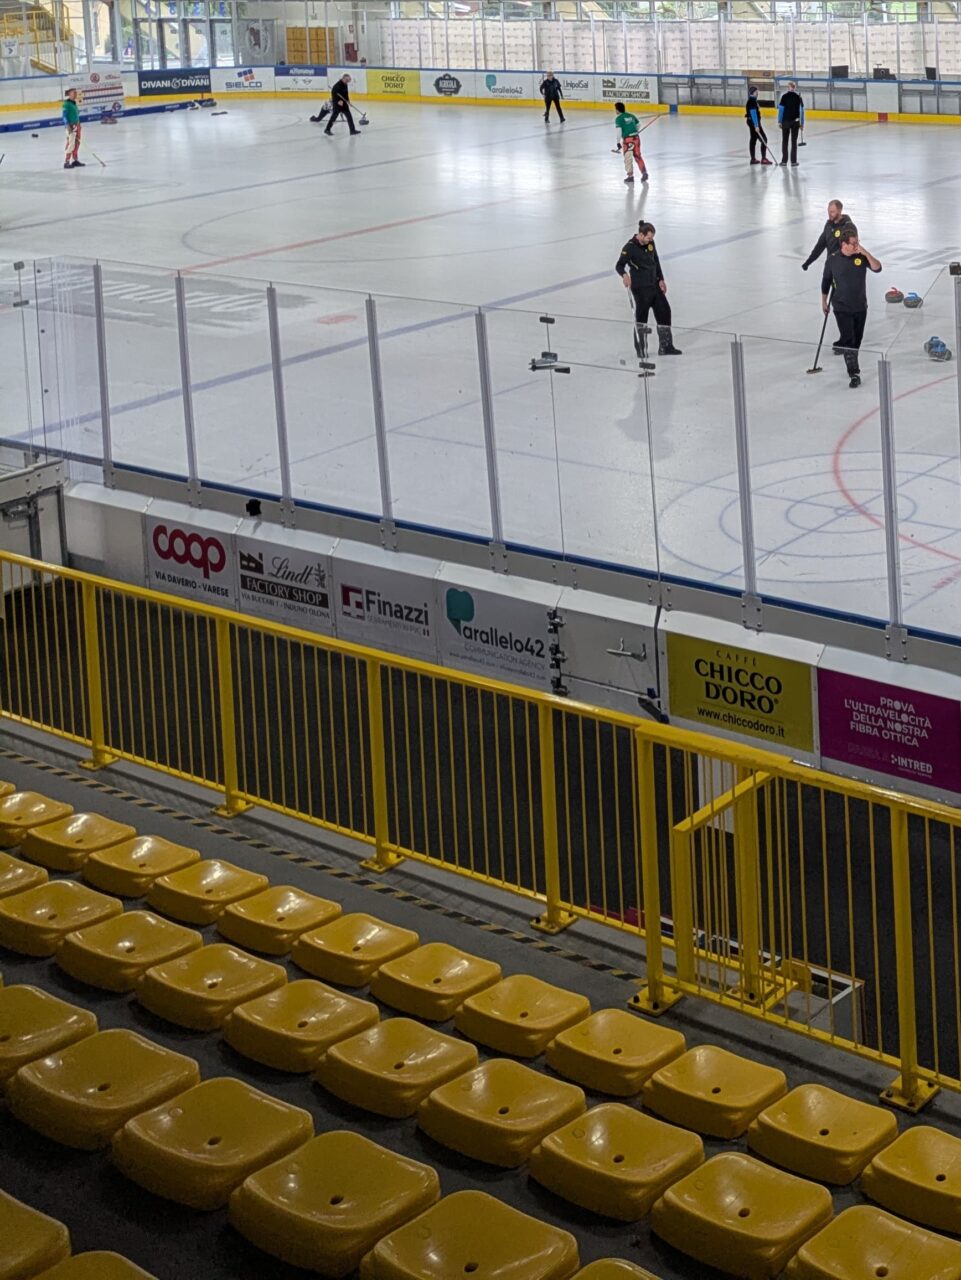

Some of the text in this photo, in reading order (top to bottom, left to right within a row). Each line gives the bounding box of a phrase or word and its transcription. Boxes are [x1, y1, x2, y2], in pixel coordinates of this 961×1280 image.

[141, 80, 171, 89] DIVANI
[181, 78, 209, 87] DIVANI
[153, 524, 226, 579] coop
[155, 570, 167, 580] VIA
[167, 574, 197, 589] DAVERIO
[202, 583, 229, 597] VARESE
[268, 556, 314, 584] Lindt
[246, 577, 322, 606] FACTORY SHOP
[365, 589, 429, 626] Finazzi
[695, 658, 782, 695] CHICCO
[880, 696, 916, 714] PROVA
[697, 706, 785, 737] www.chiccodoro.it
[850, 721, 919, 747] FIBRA OTTICA
[853, 711, 928, 739] DELLA NOSTRA
[898, 756, 933, 774] INTRED
